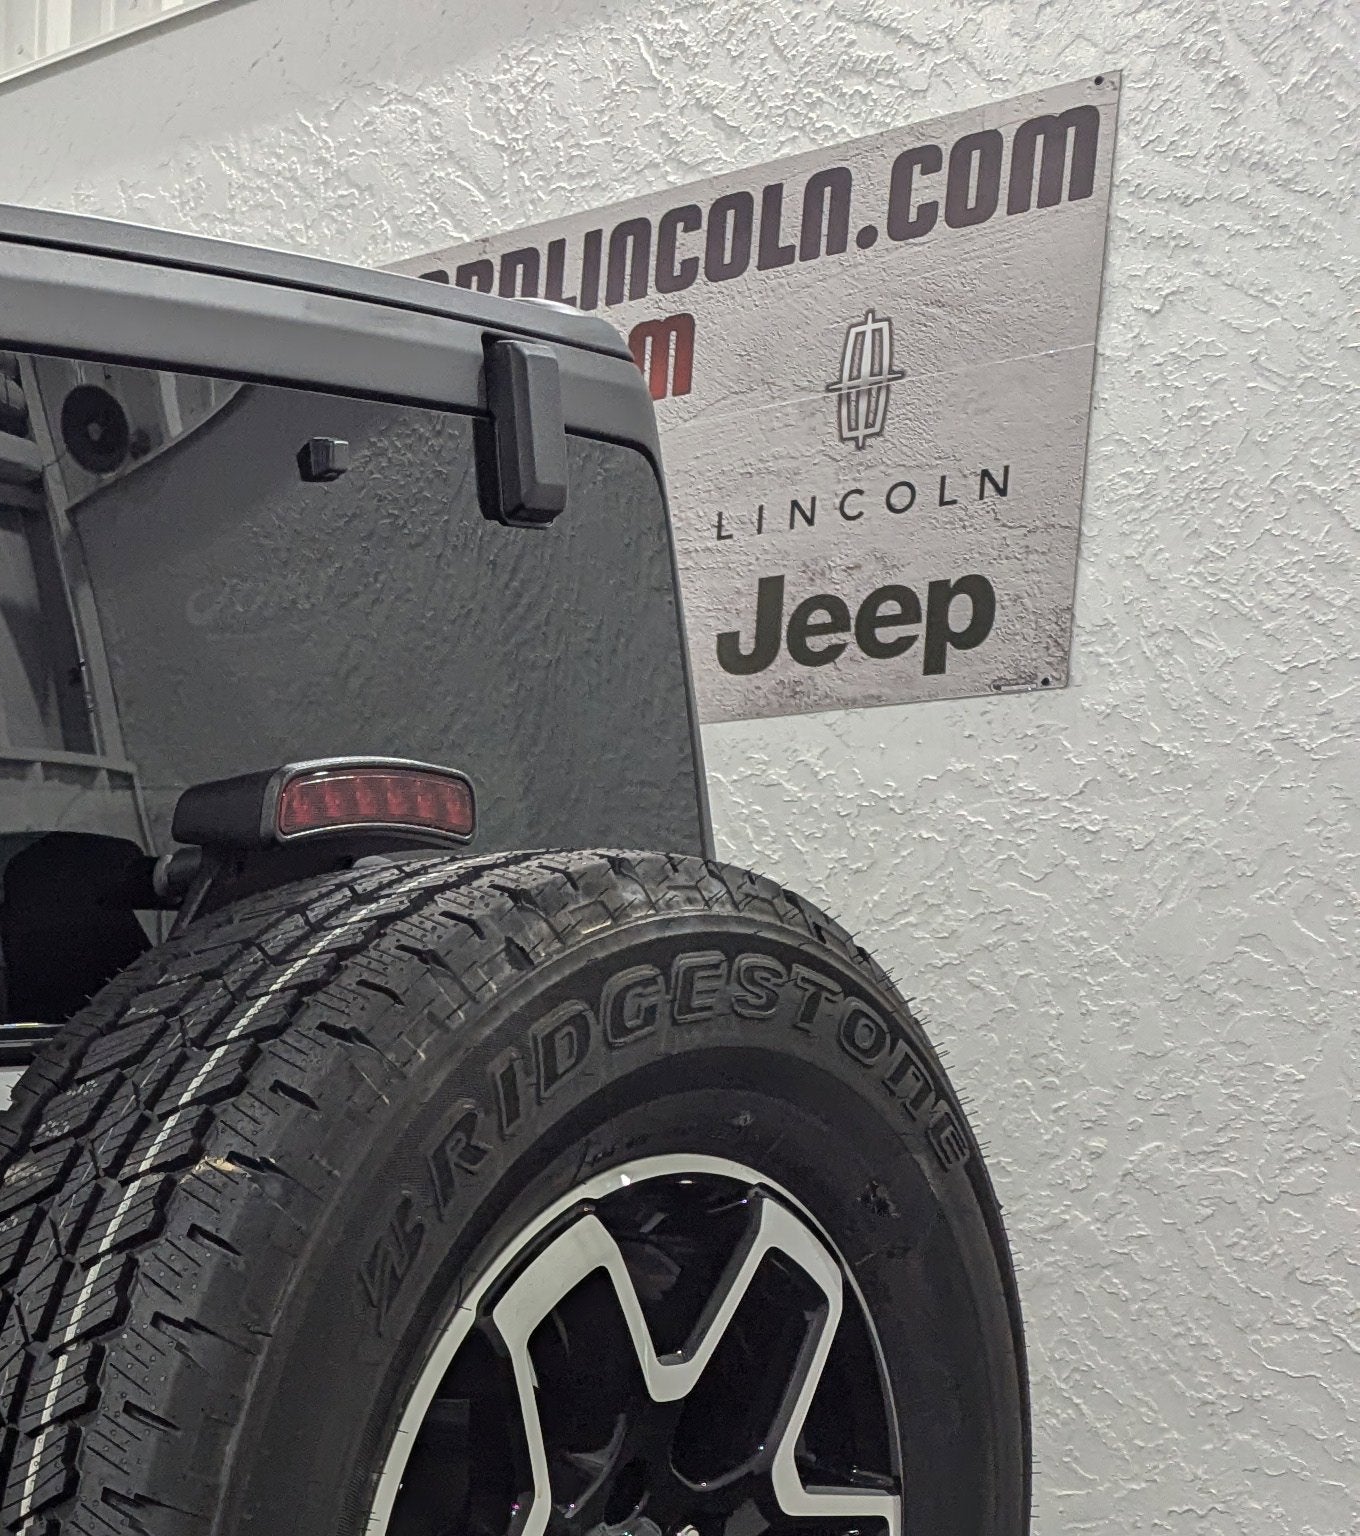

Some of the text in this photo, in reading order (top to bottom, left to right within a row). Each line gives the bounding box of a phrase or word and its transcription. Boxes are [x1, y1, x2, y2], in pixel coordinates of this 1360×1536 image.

[716, 464, 1013, 542] LINCOLN
[716, 571, 997, 677] Jeep
[358, 950, 970, 1322] BRIDGESTONE
